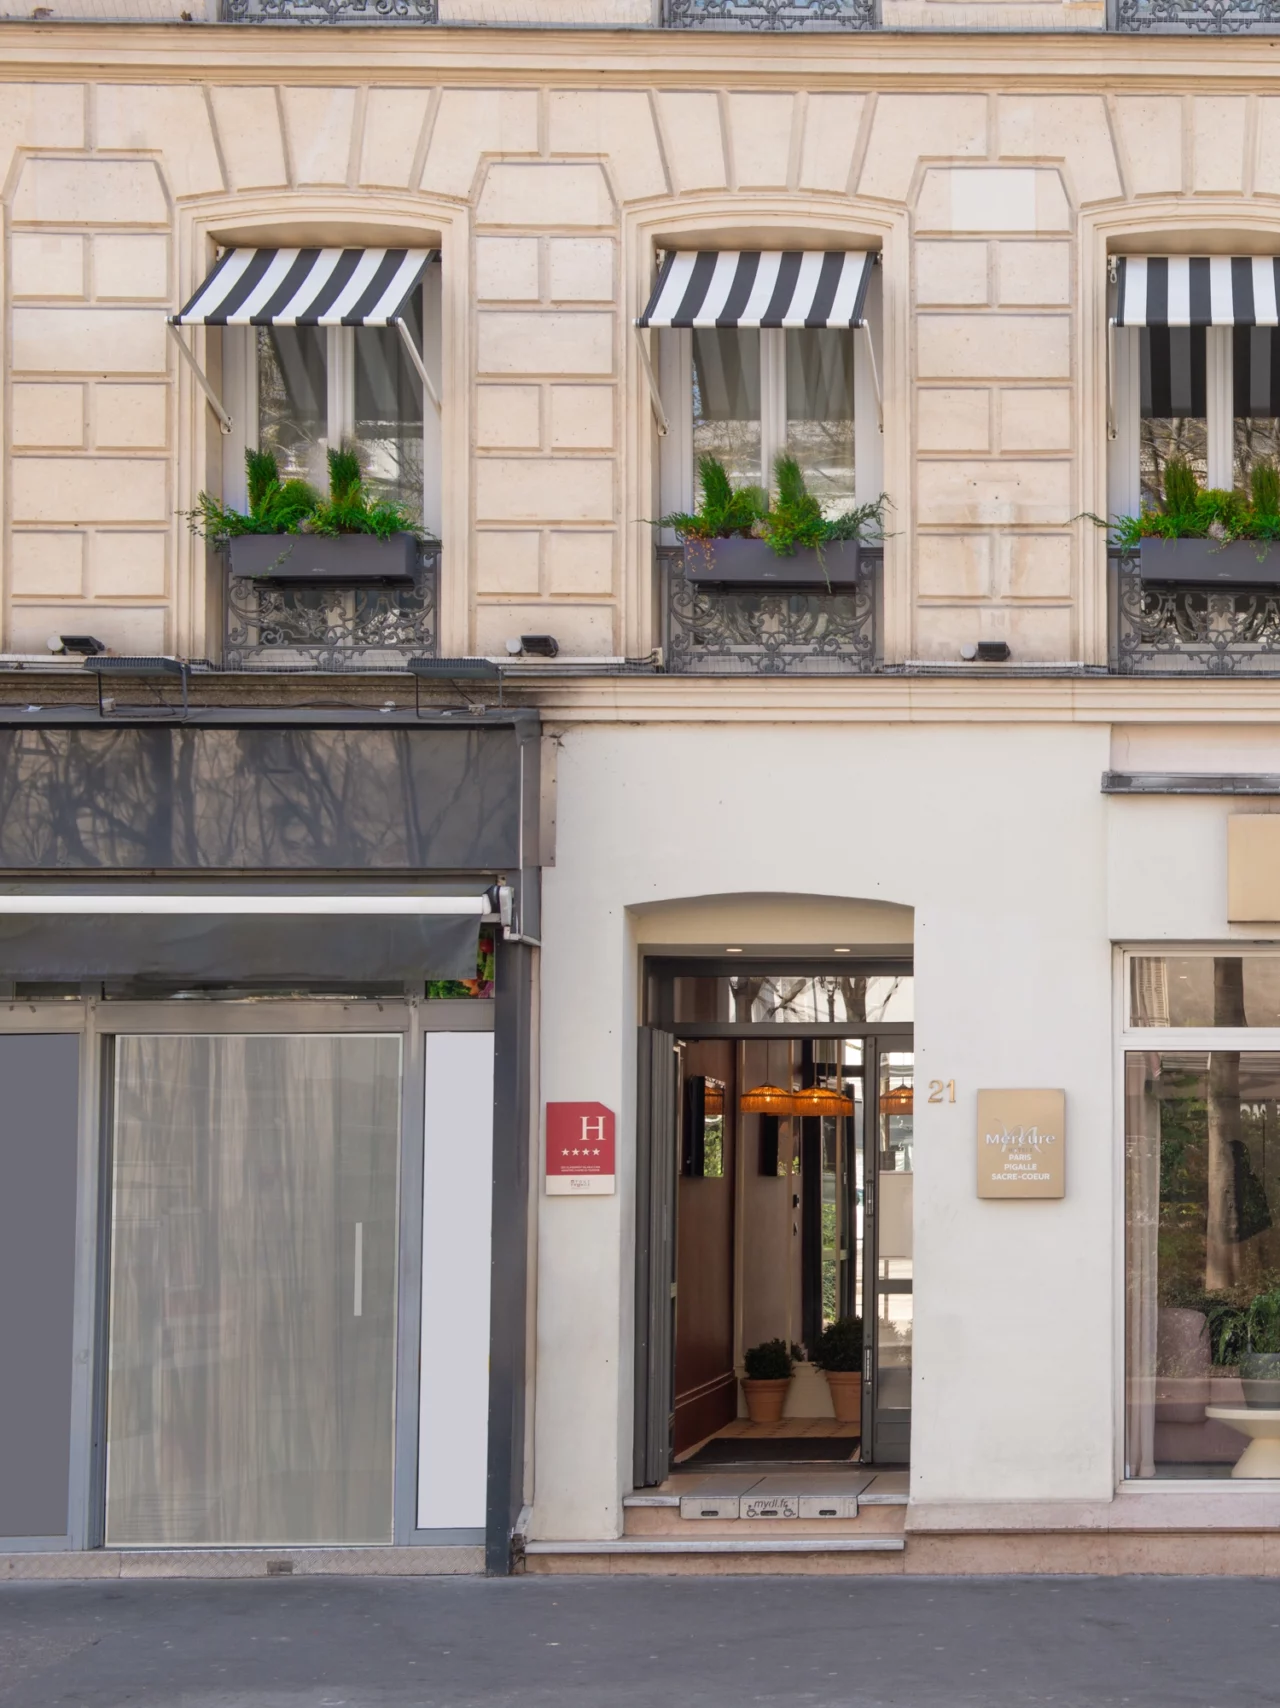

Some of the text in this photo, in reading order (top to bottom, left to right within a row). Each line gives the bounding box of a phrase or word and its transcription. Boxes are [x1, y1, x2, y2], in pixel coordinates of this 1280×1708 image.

[928, 1079, 956, 1103] 21
[579, 1115, 606, 1141] H
[985, 1133, 1056, 1145] Mercure
[1008, 1153, 1032, 1161] PARIS
[1004, 1163, 1038, 1171] PIGALLE
[991, 1173, 1051, 1181] SACRE-COEUR
